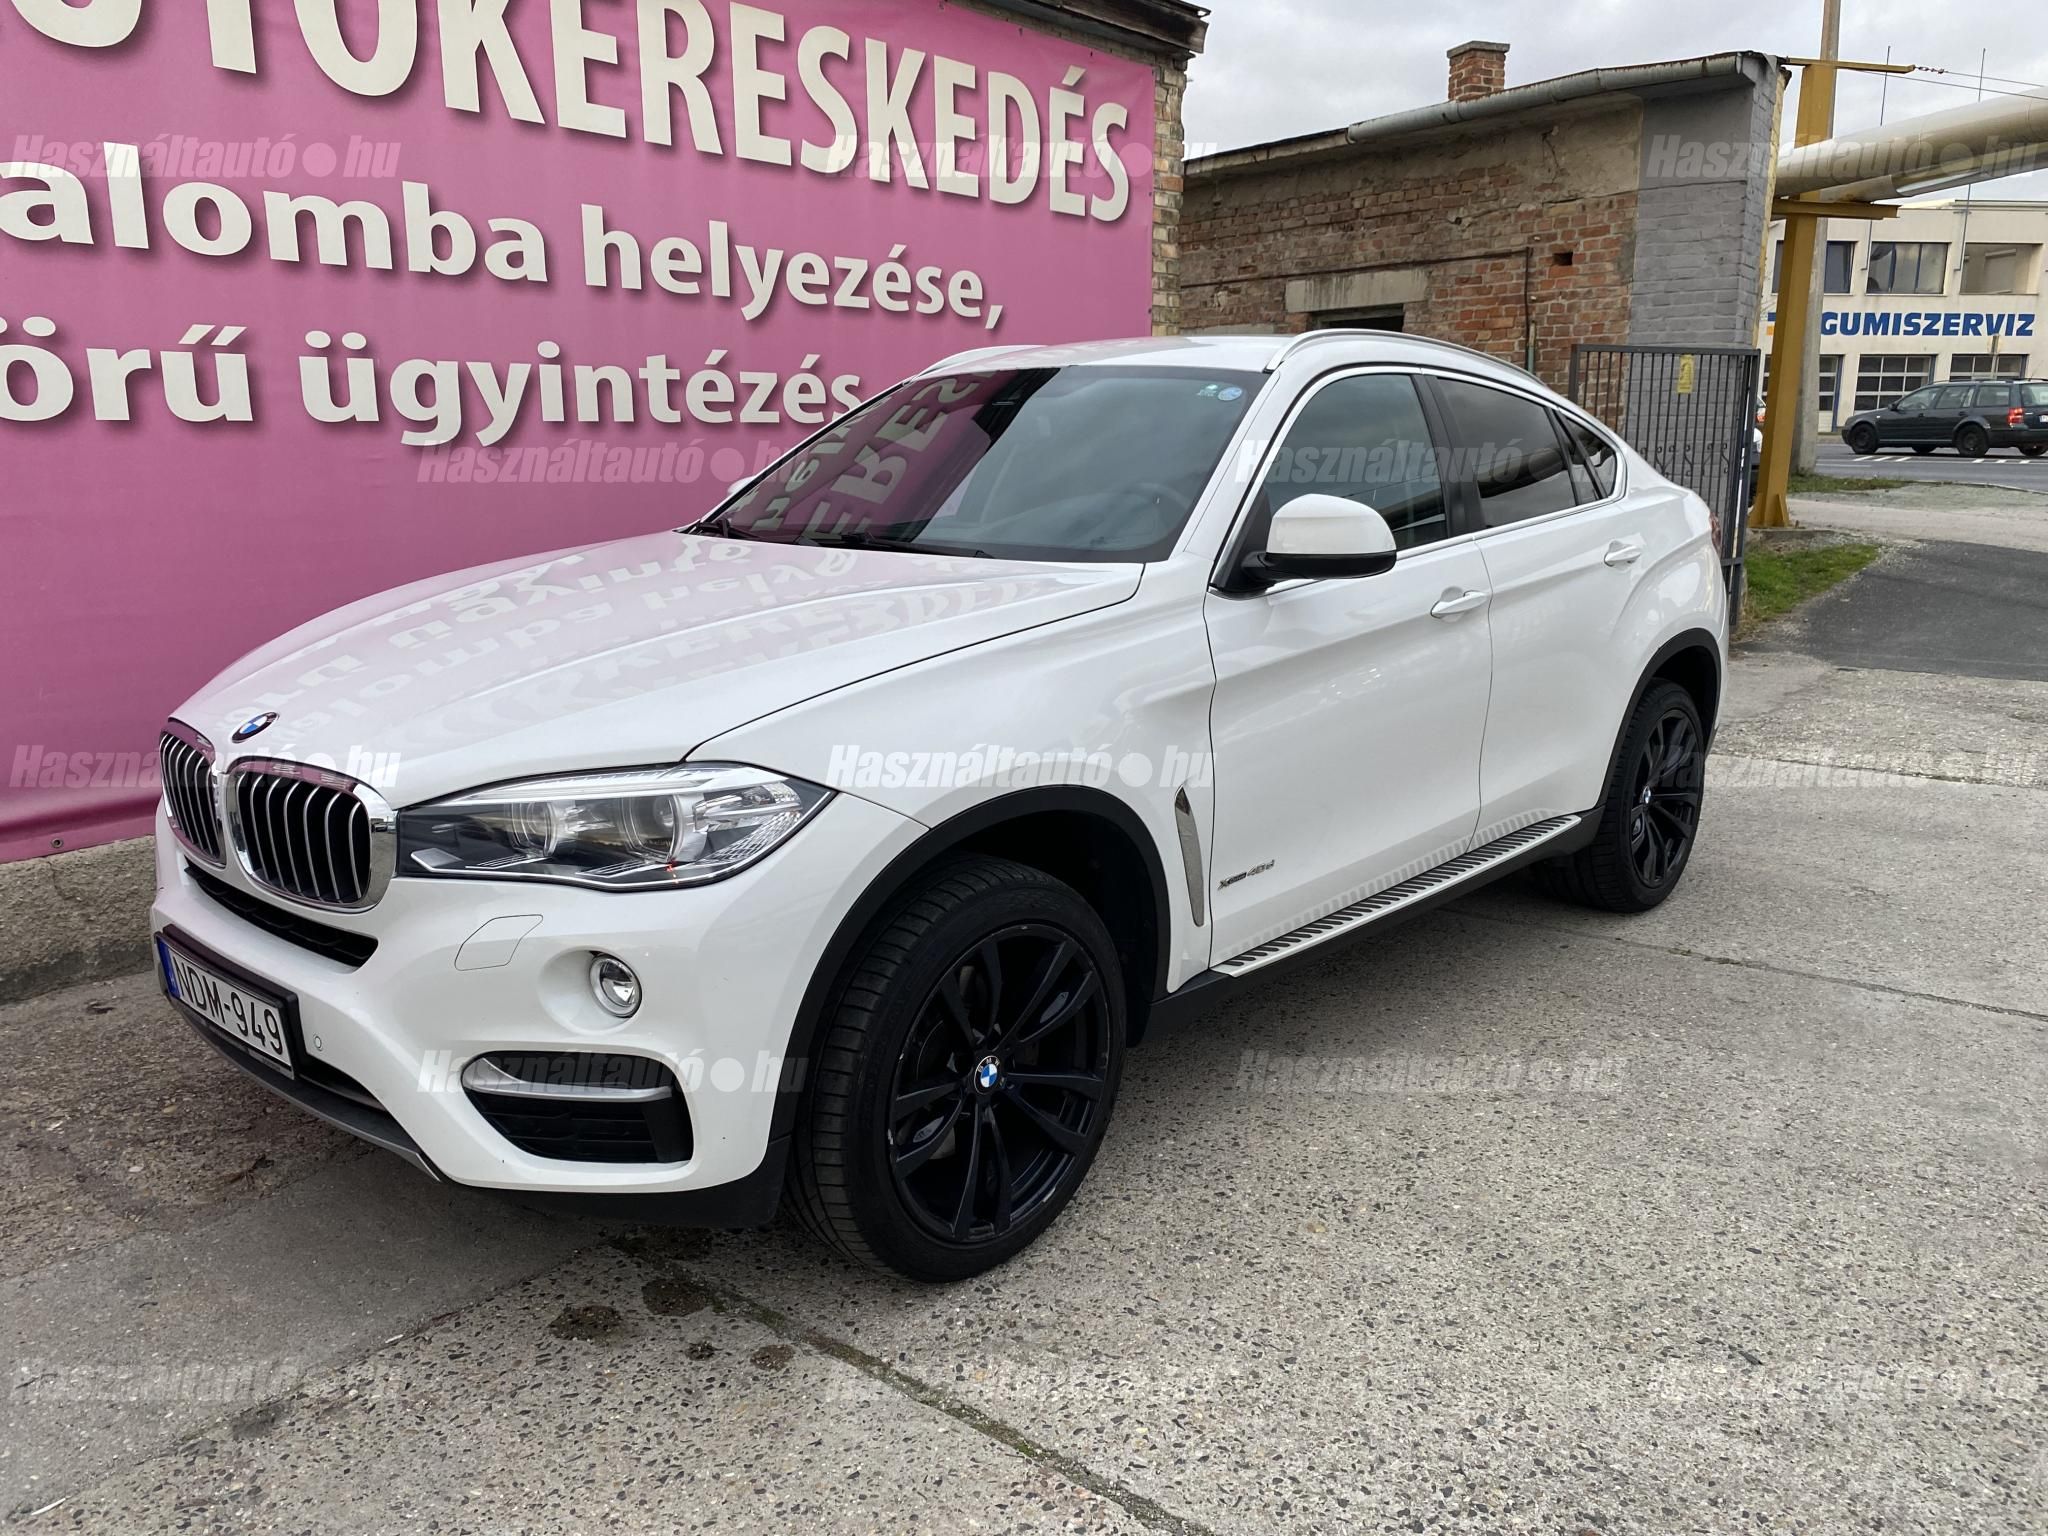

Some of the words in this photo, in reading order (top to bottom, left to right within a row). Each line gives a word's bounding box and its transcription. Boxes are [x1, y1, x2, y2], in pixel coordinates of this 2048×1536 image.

[8, 0, 1129, 222] KERESKEDÉS
[0, 141, 548, 283] alomba
[581, 202, 1004, 330] helyezése,
[0, 314, 254, 423] örű
[299, 329, 861, 448] ügyintézés
[1820, 311, 2036, 336] GUMISZERVIZ
[173, 956, 284, 1056] NDM-949
